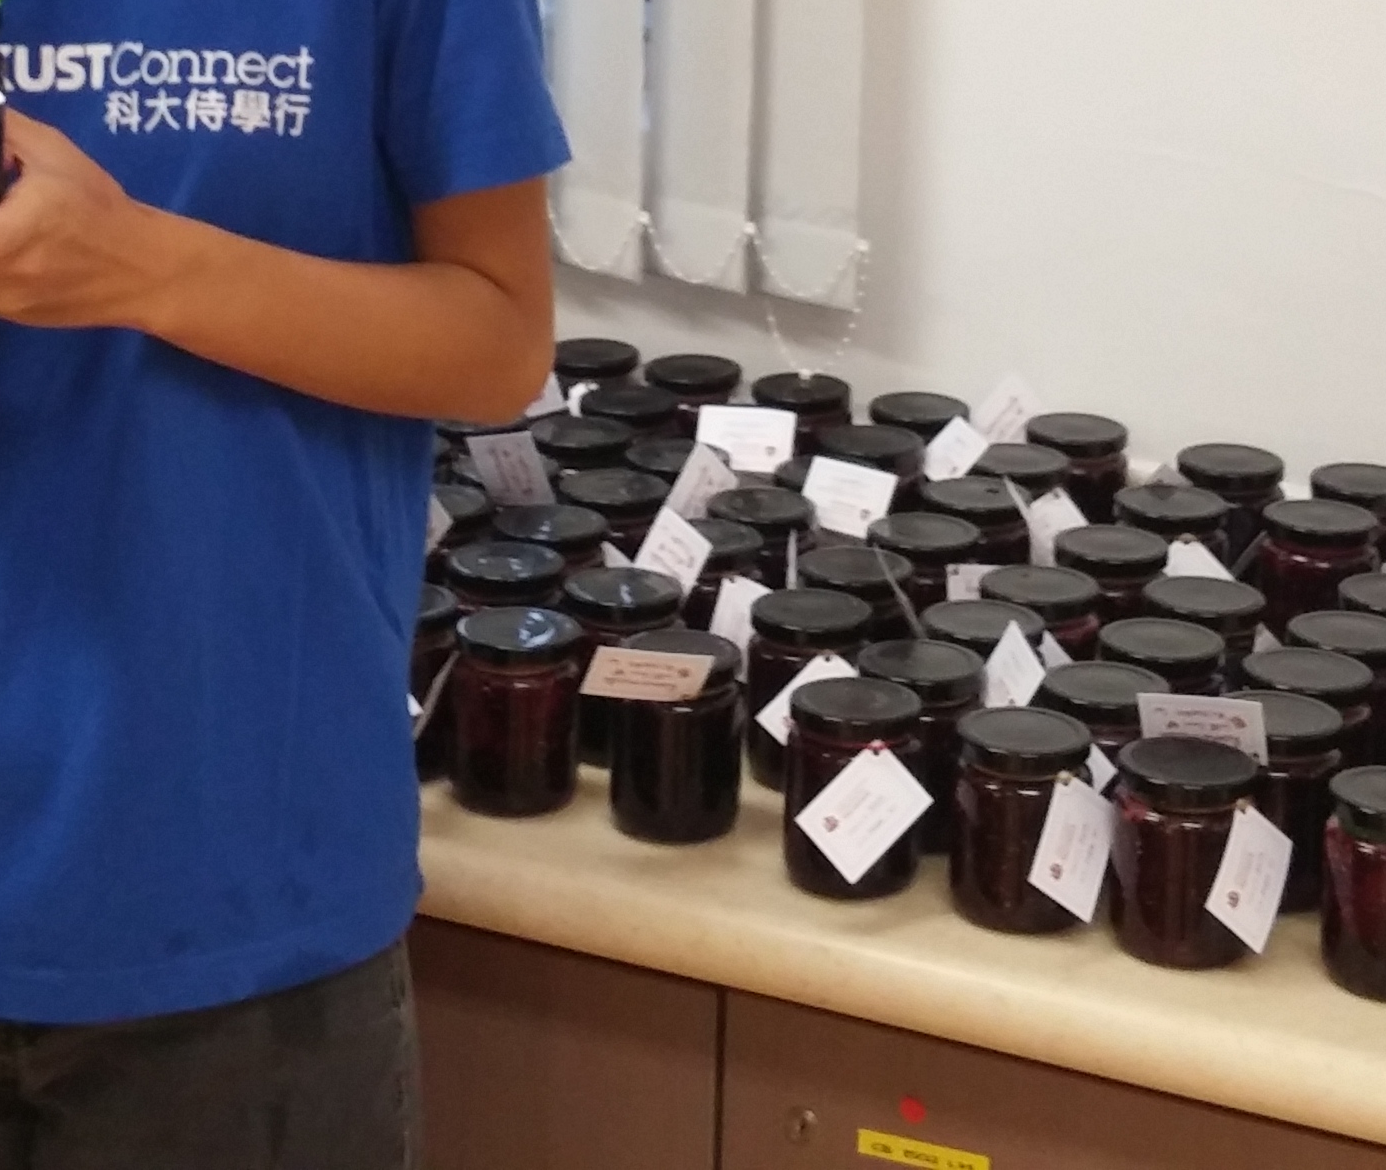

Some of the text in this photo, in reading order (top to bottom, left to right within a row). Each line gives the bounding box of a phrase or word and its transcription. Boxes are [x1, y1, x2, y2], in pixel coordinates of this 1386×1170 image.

[105, 90, 311, 137] 科大侍學行
